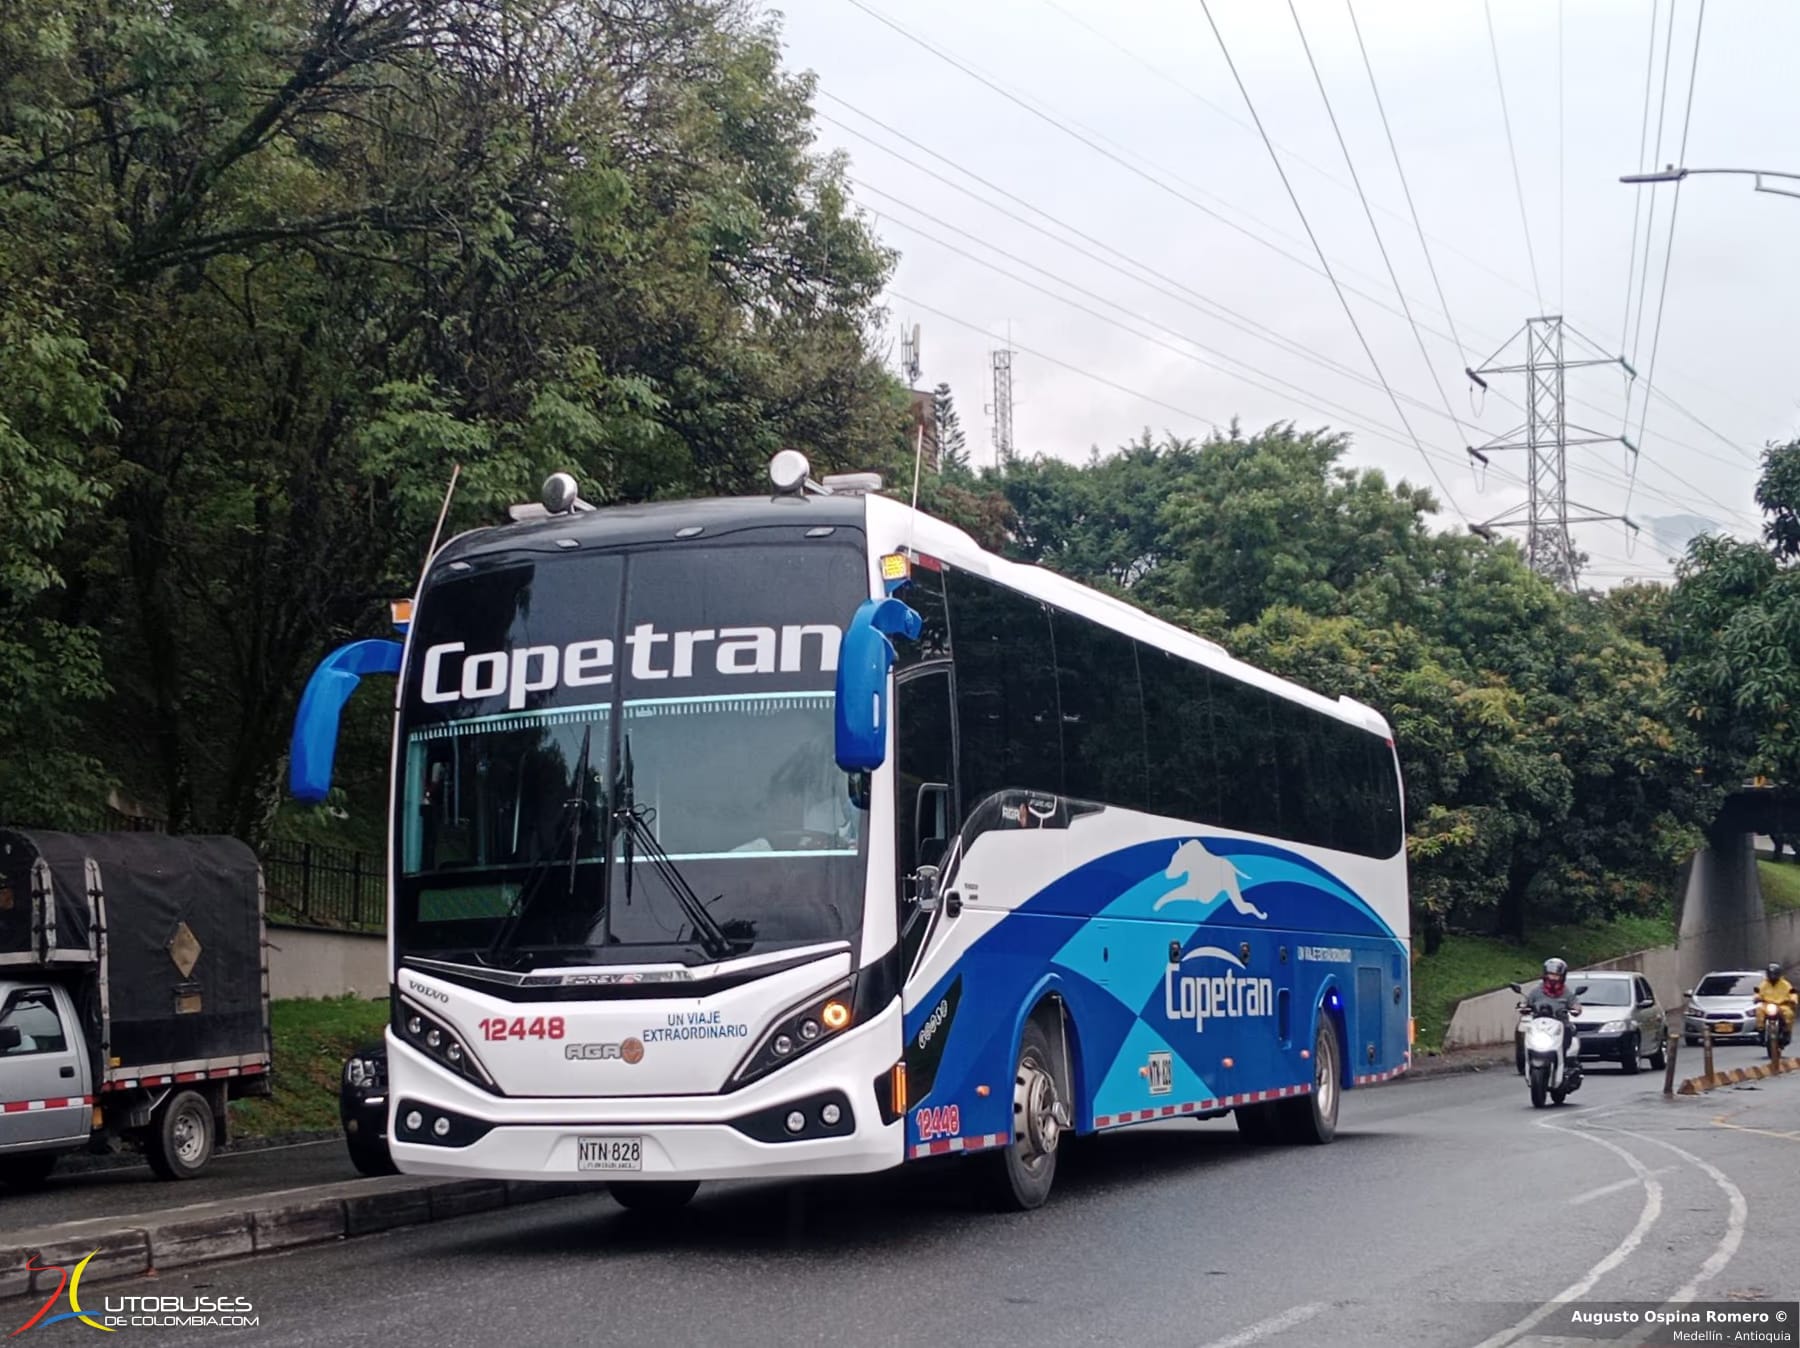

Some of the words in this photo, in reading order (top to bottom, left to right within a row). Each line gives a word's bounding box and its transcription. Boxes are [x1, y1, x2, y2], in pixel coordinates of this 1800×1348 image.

[421, 623, 843, 710] Copetran
[408, 978, 449, 1004] VOLVO
[1165, 961, 1274, 1033] Copetran
[479, 1015, 566, 1042] 12448
[667, 1012, 684, 1027] UN
[687, 1010, 721, 1025] VIAJE
[642, 1023, 748, 1043] EXTRAORDINARIO
[915, 1103, 960, 1141] 12448
[580, 1142, 608, 1161] NTN
[612, 1142, 640, 1161] 828
